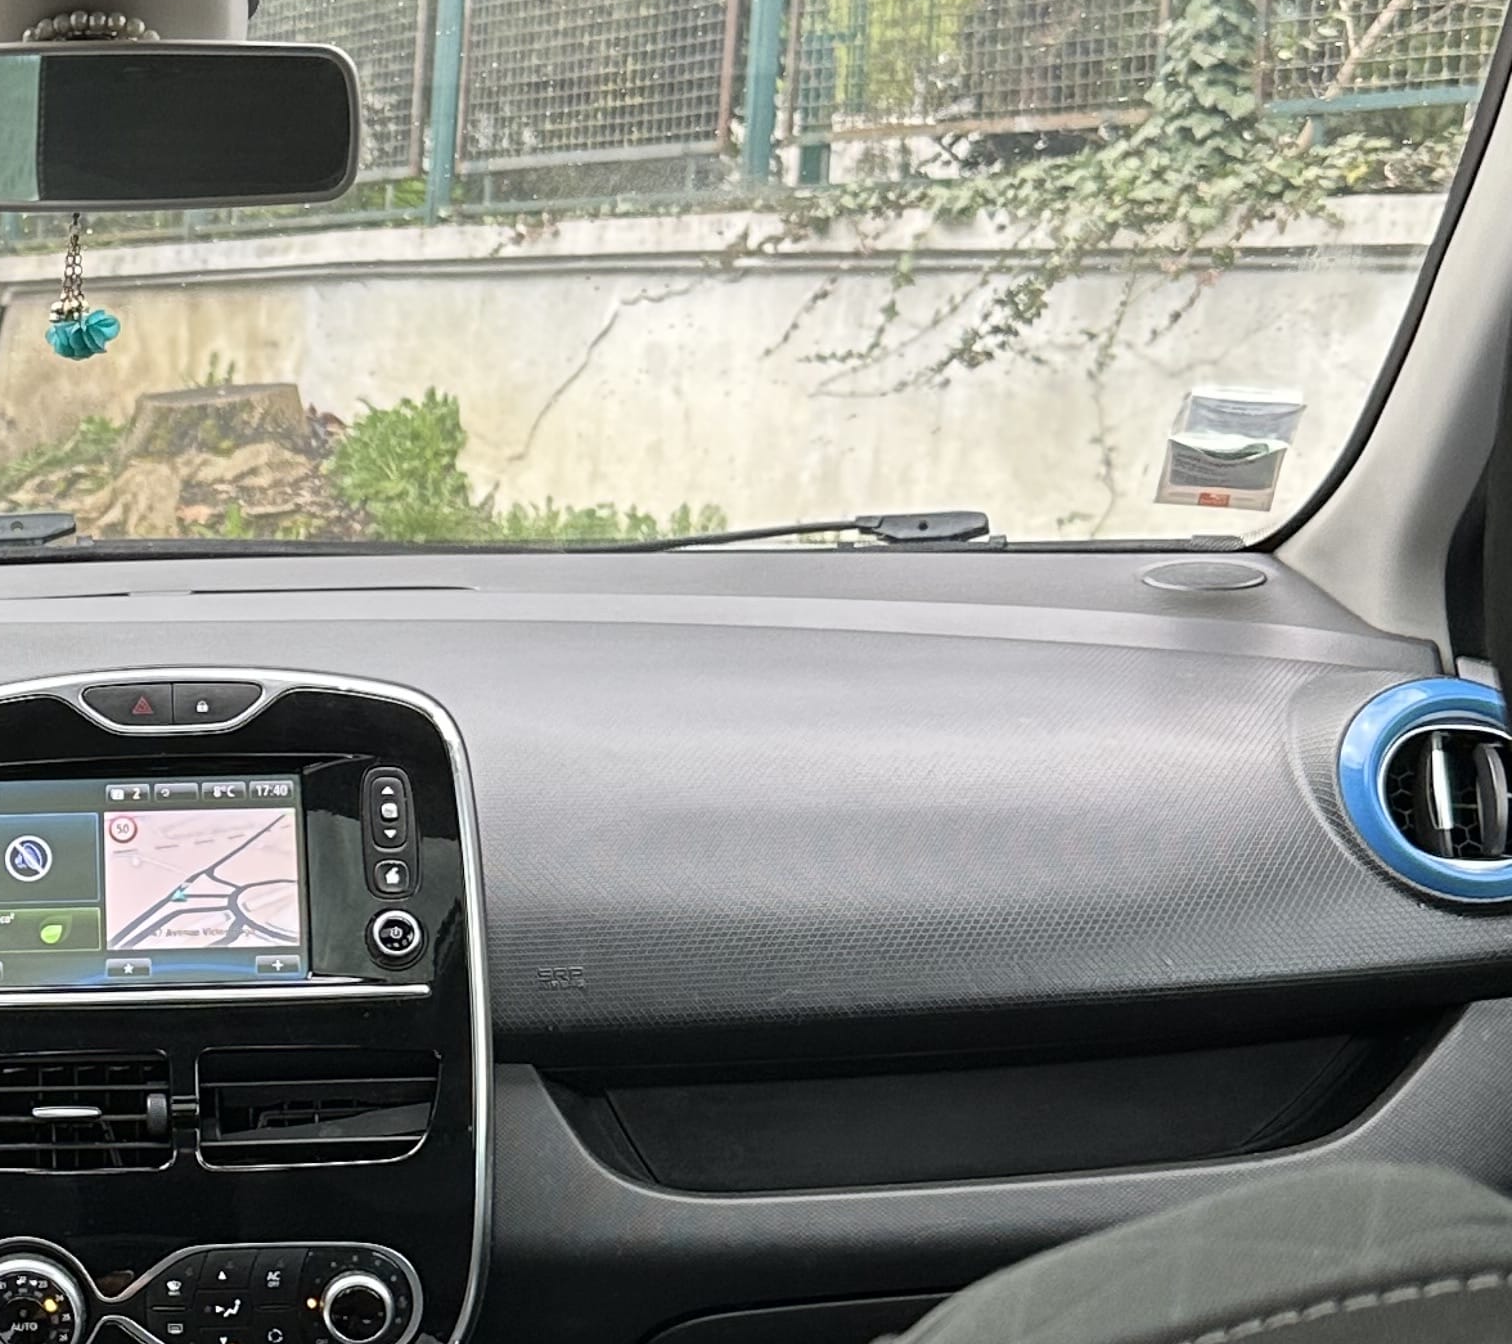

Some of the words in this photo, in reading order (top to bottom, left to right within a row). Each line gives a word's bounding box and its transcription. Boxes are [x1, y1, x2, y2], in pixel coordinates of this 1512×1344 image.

[132, 788, 141, 800] 2
[213, 785, 236, 798] 8°C
[255, 784, 288, 797] 17:40
[267, 1271, 281, 1281] AC
[11, 1322, 38, 1331] AUTO
